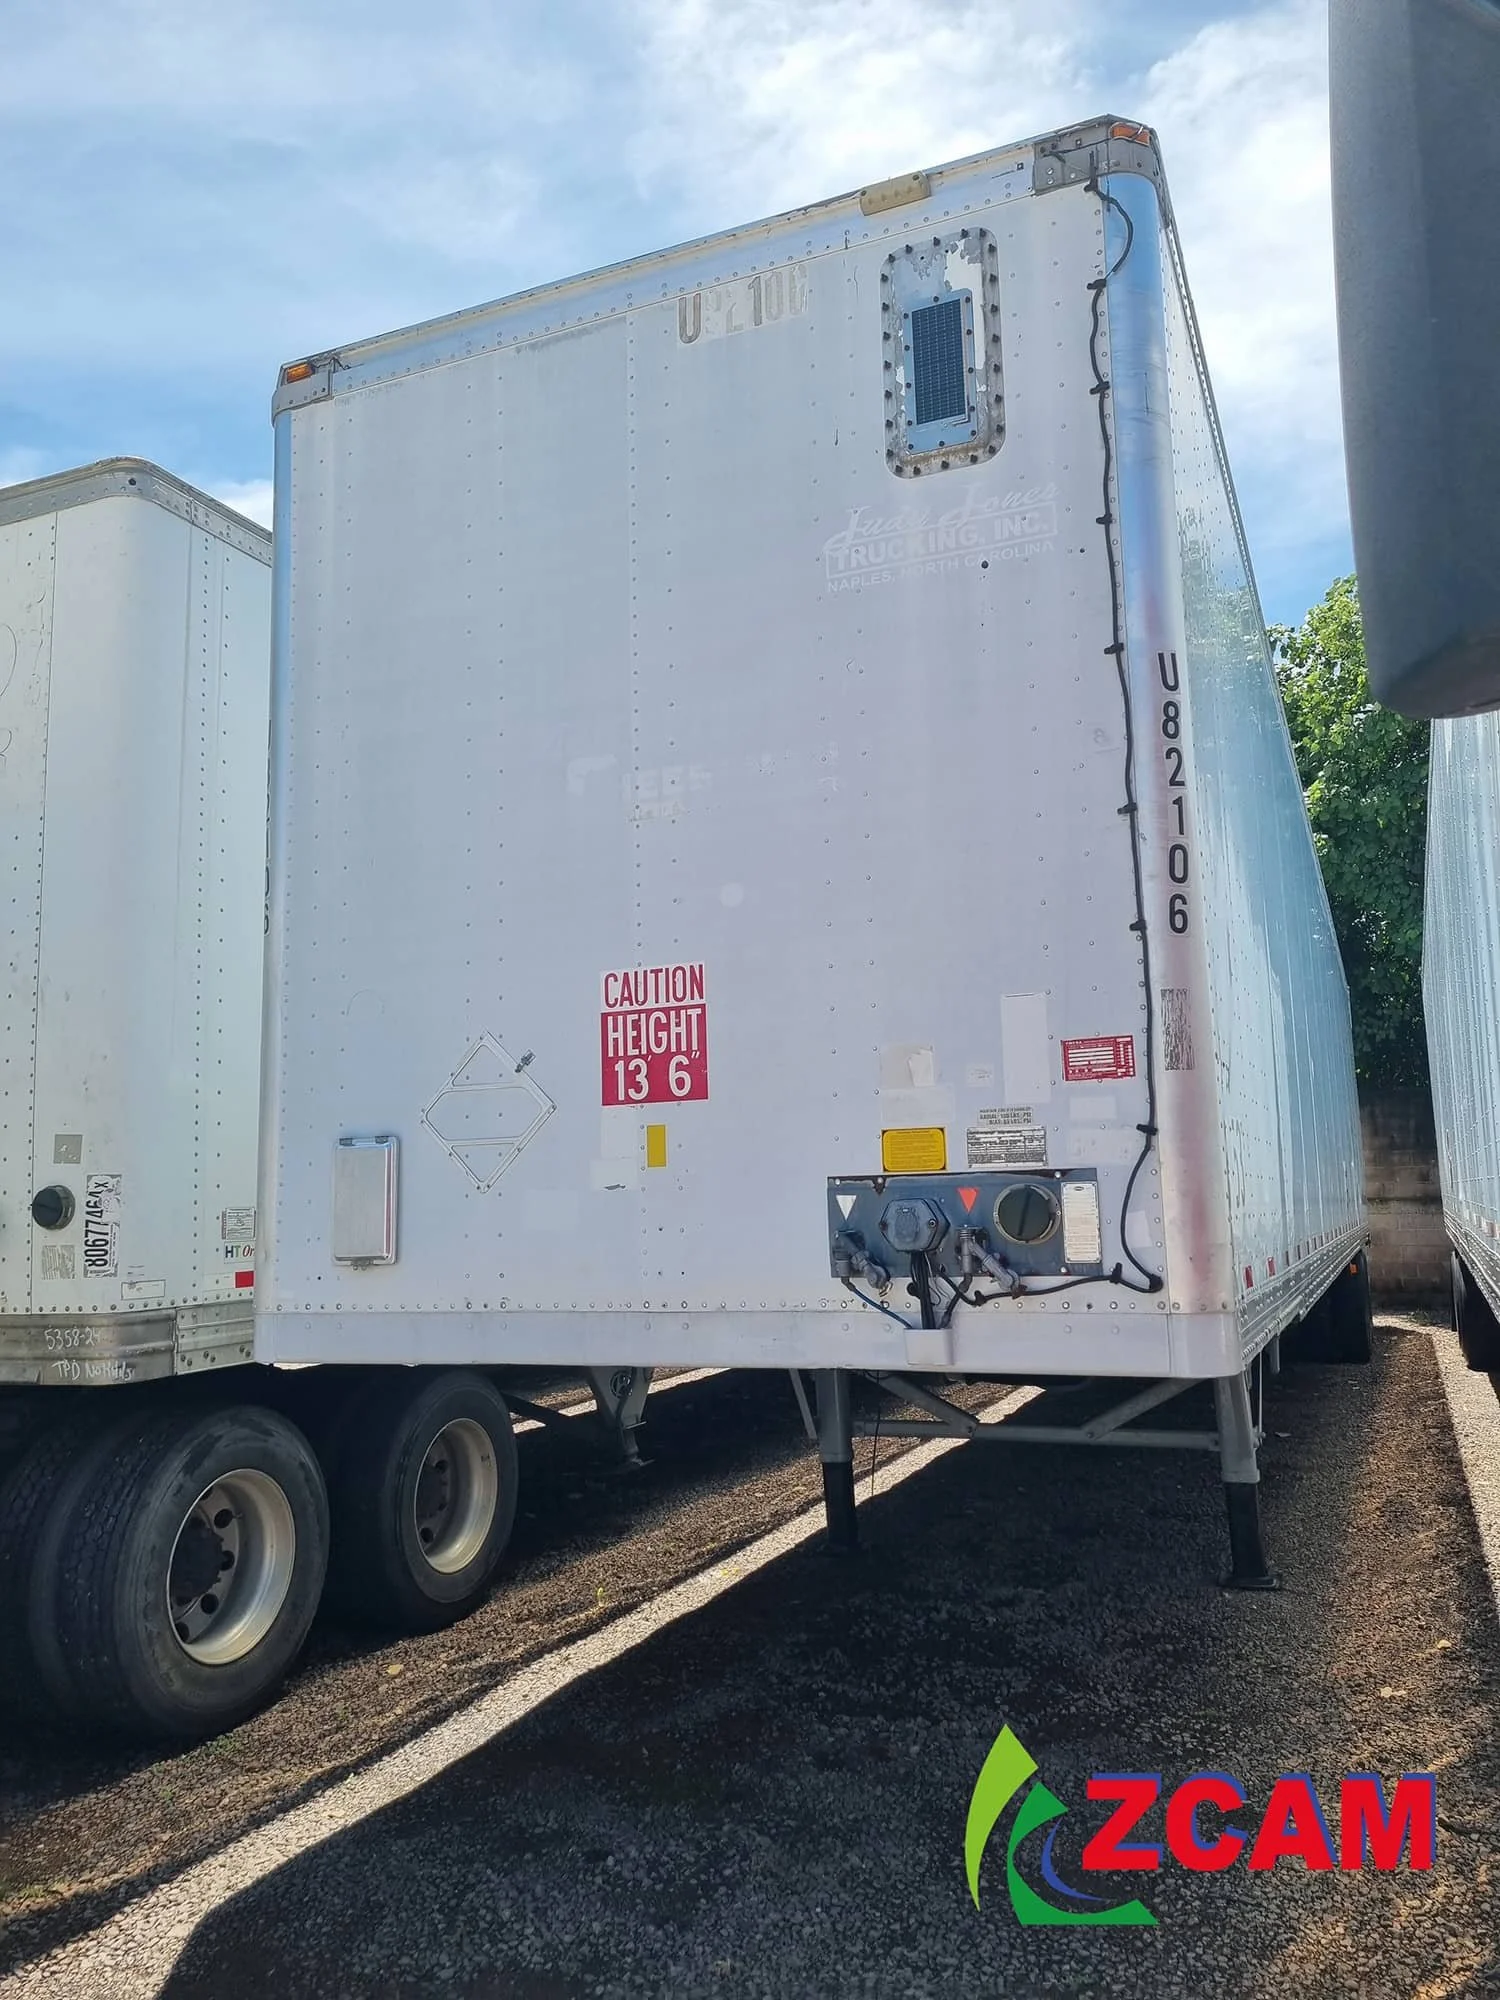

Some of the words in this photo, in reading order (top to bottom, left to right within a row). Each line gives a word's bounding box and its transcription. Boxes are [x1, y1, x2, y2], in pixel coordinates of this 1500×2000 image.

[994, 511, 1049, 541] INC.
[828, 570, 896, 593] NAPLES,
[965, 540, 1056, 568] CAROLINA
[1158, 652, 1188, 934] U82106
[604, 964, 704, 1008] CAUTION
[607, 1008, 702, 1057] HEIGHT
